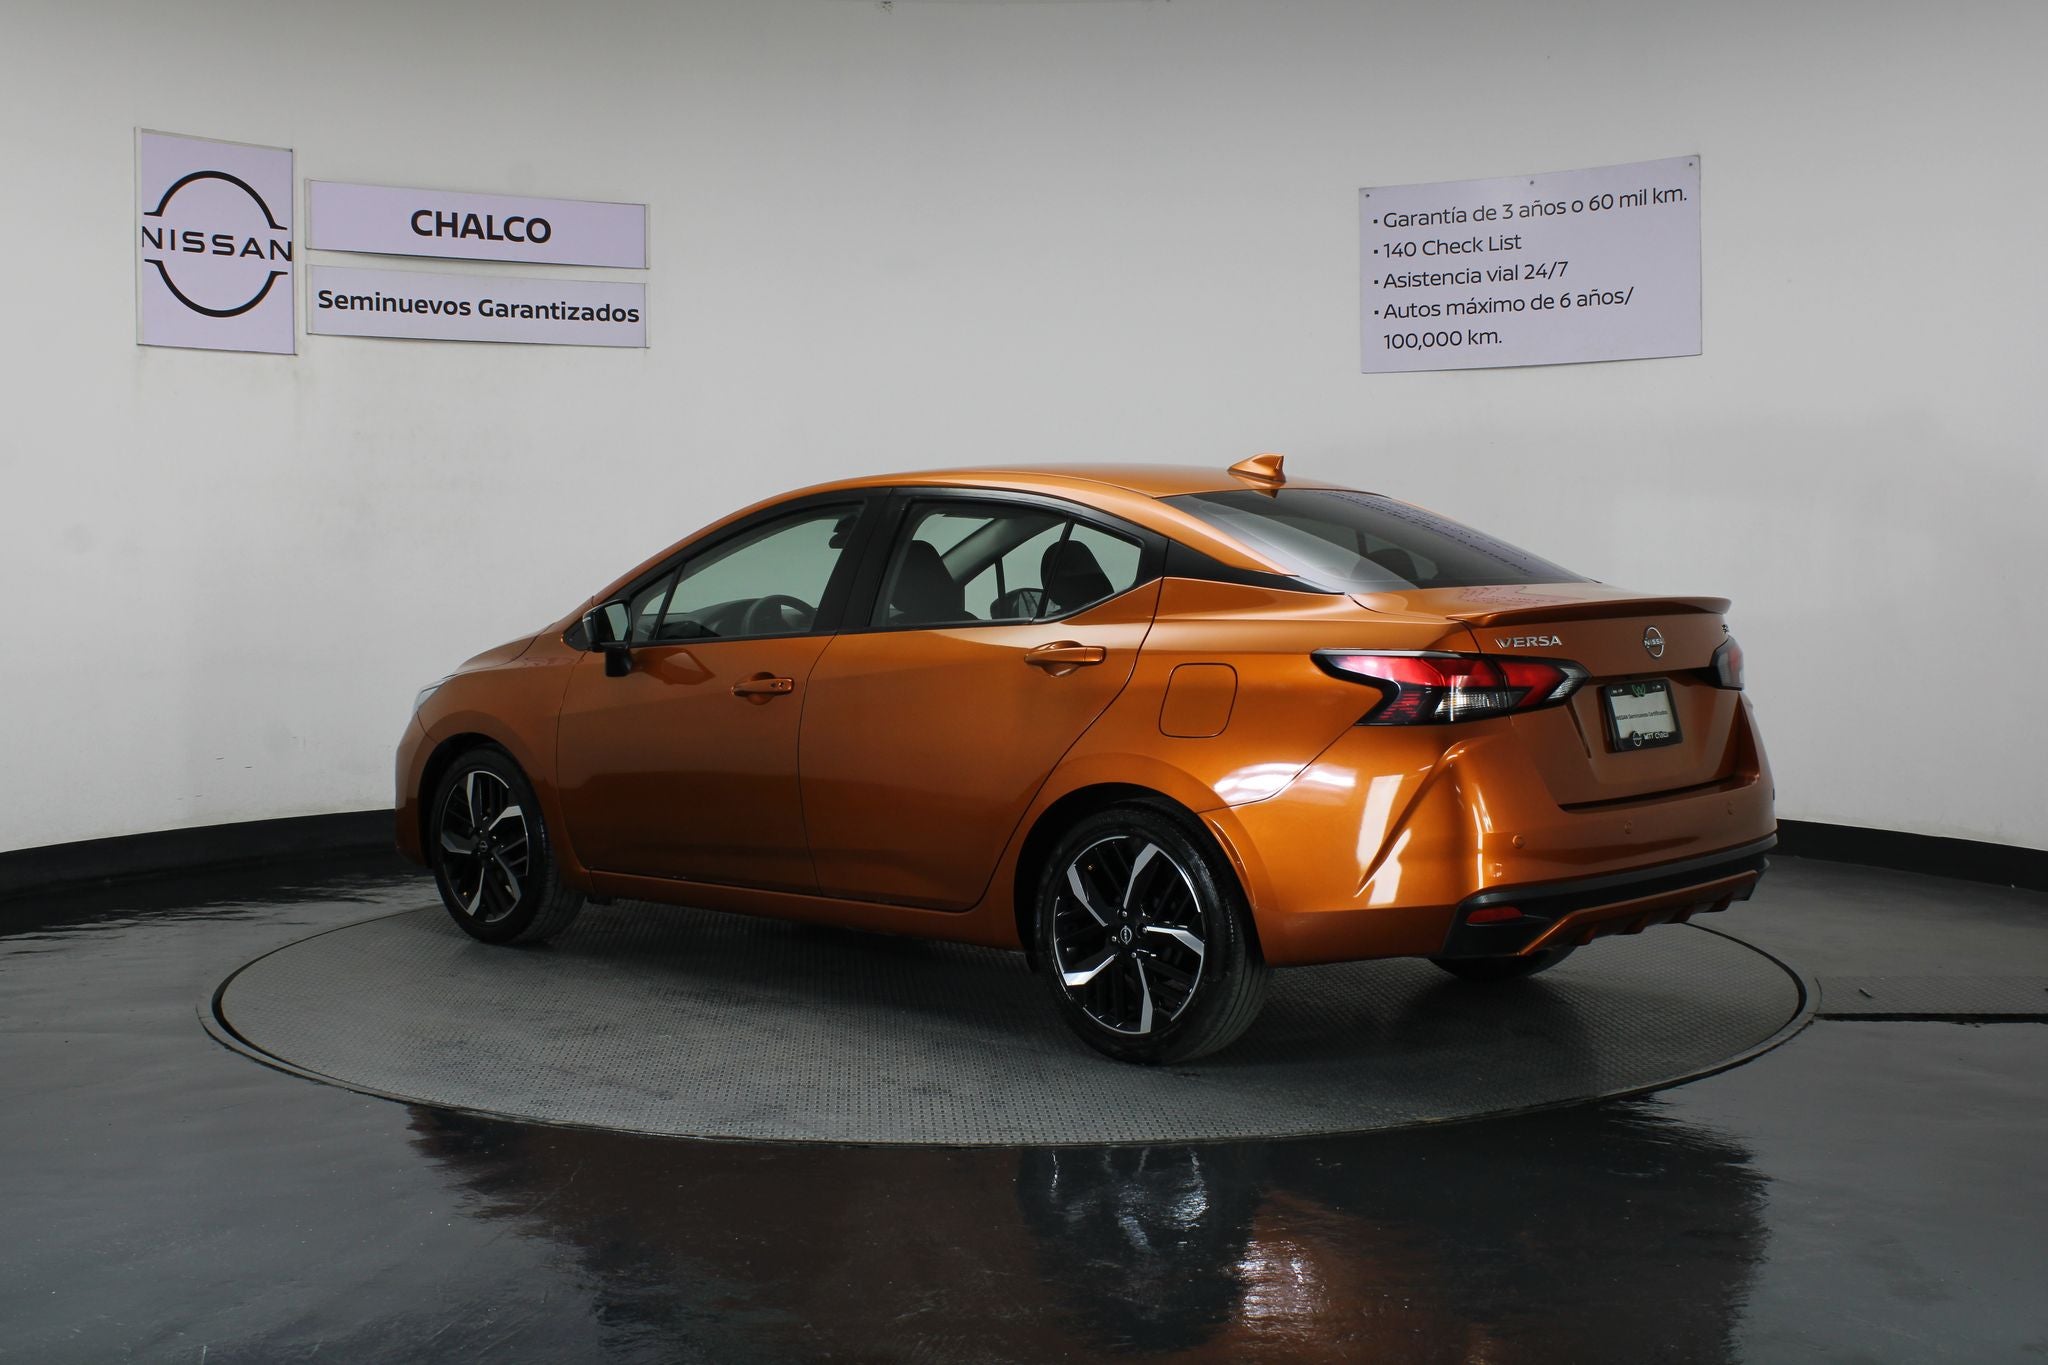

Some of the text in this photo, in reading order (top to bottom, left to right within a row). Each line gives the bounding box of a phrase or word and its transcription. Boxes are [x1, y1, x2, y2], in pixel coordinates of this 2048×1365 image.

[1383, 187, 1688, 228] Garantía de 3 años o 60 mil km.
[411, 209, 551, 243] CHALCO
[142, 225, 293, 262] NISSAN
[1383, 234, 1522, 258] 140 Check List
[1383, 261, 1568, 289] Asistencia vial 24/7
[318, 289, 639, 323] Seminuevos Garantizados
[1383, 286, 1634, 319] Autos máximo de 6 años/
[1383, 329, 1503, 351] 100,000 km.
[1495, 635, 1562, 649] VERSA
